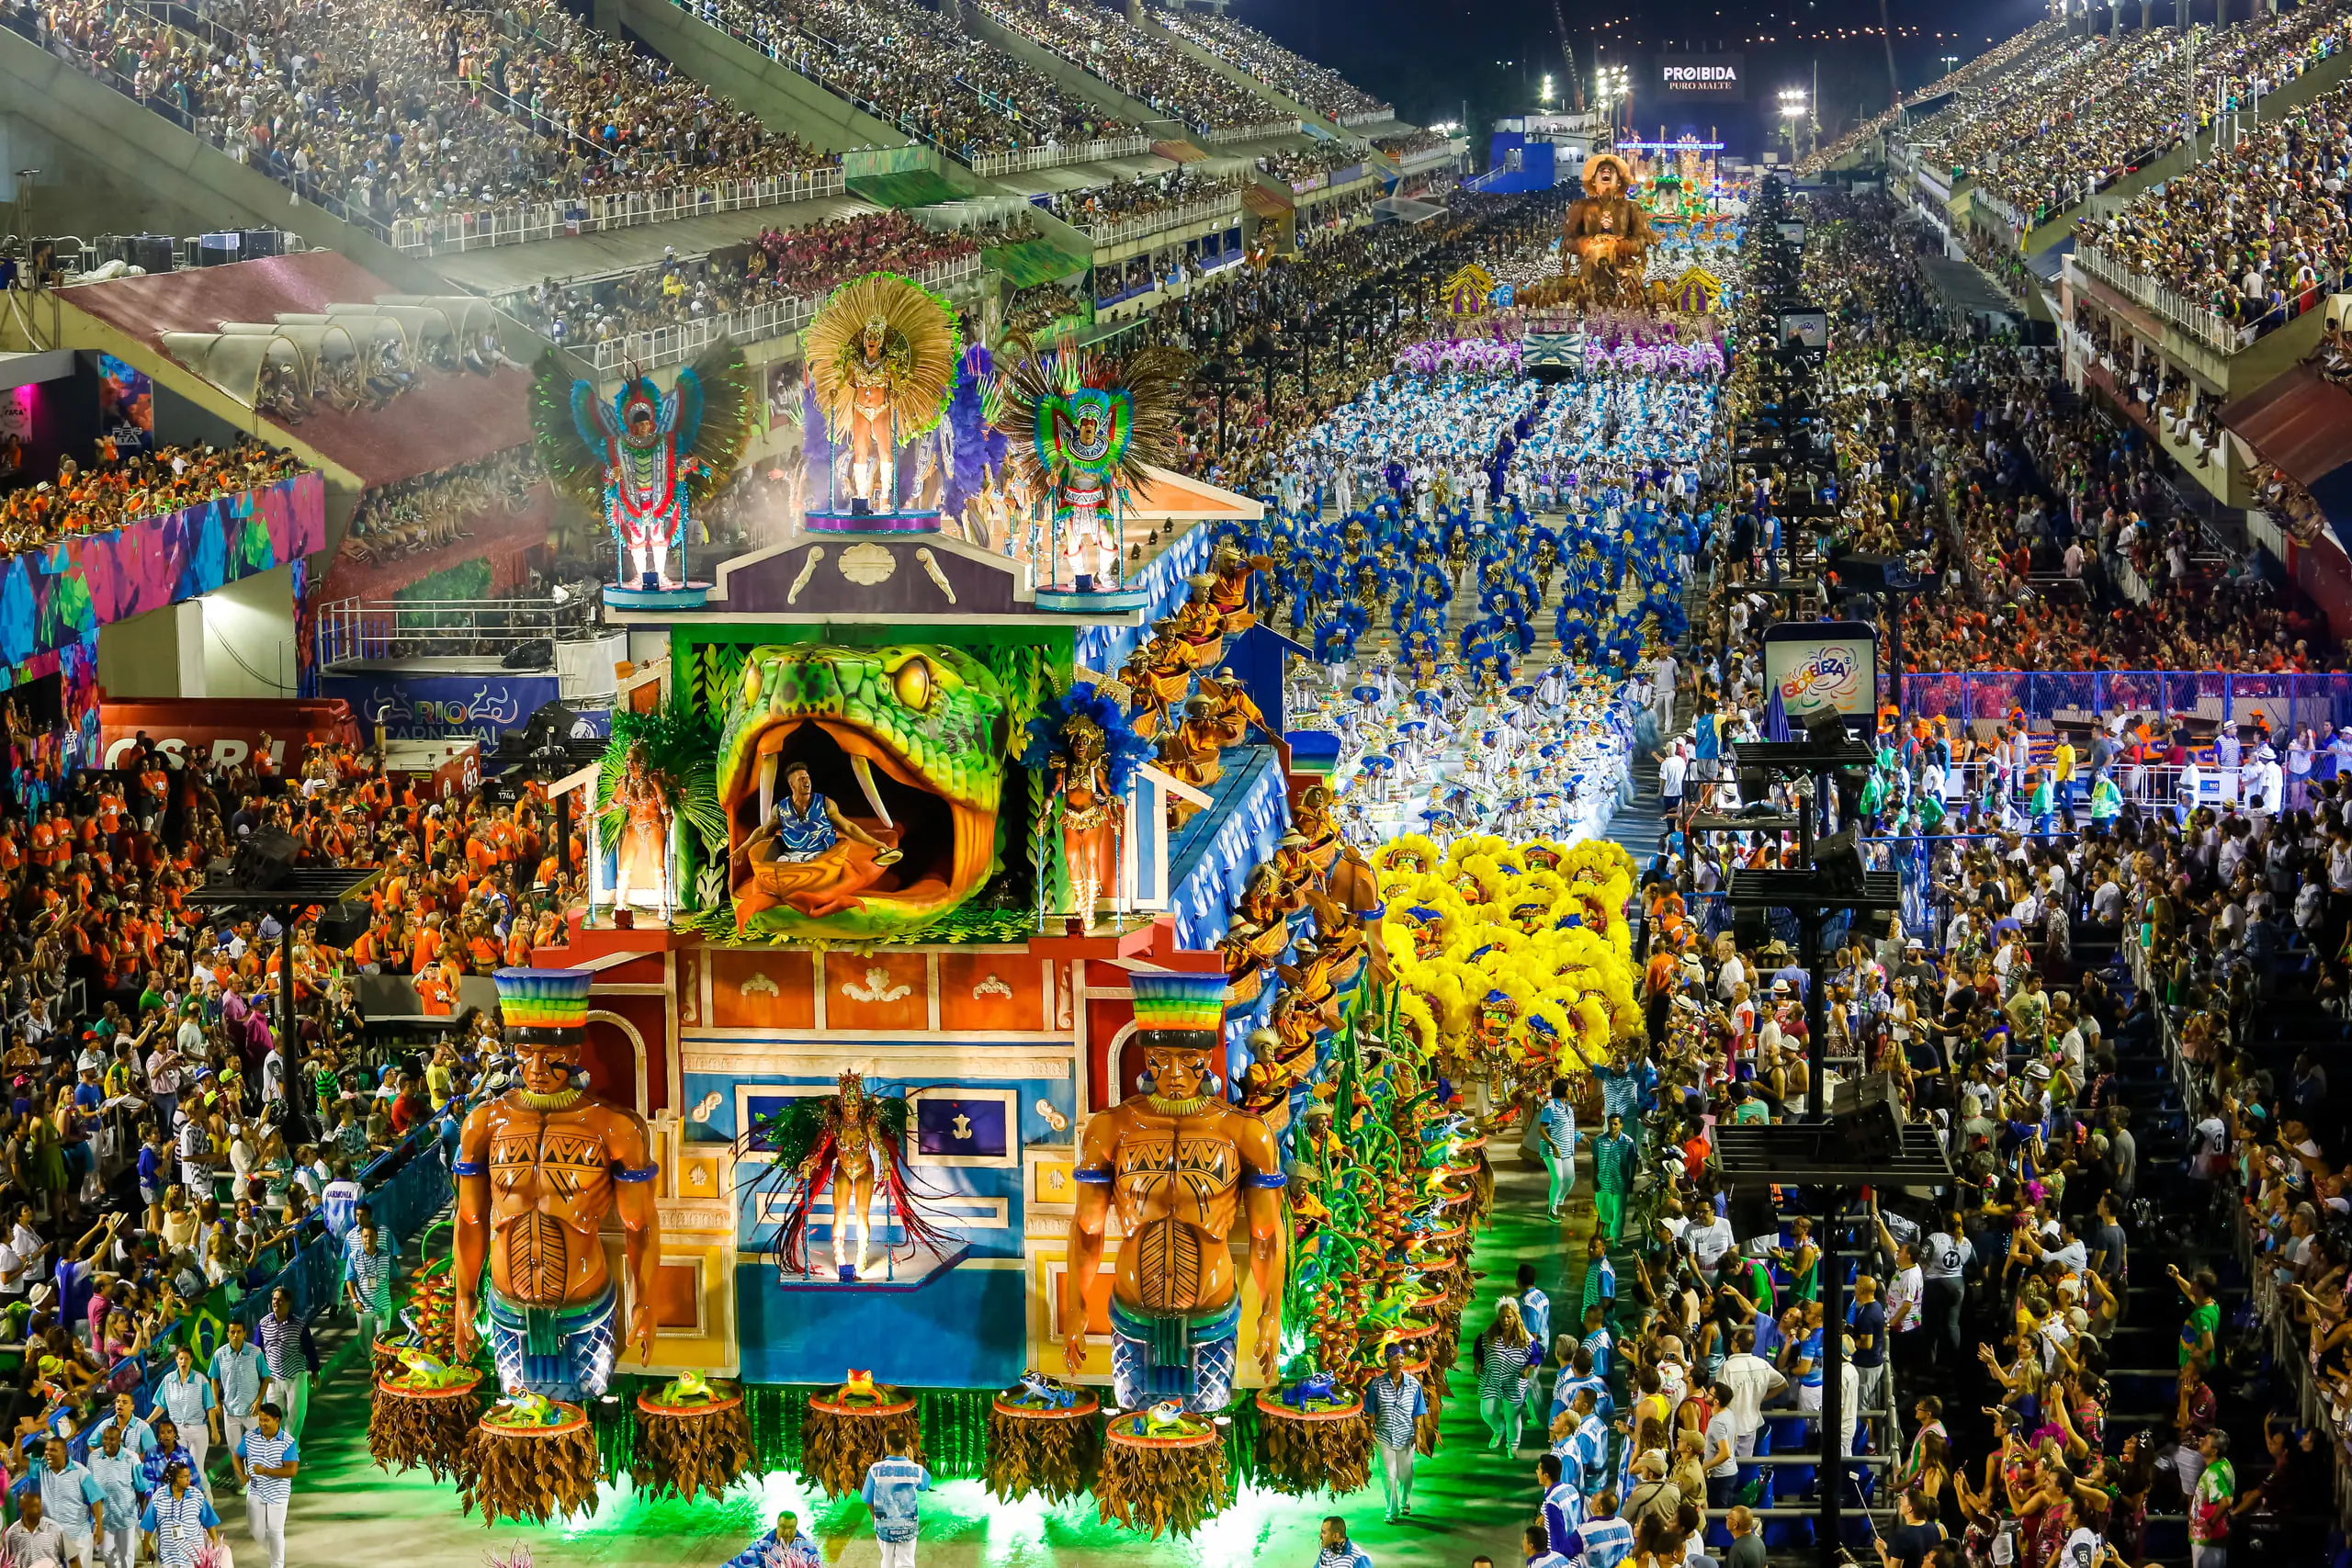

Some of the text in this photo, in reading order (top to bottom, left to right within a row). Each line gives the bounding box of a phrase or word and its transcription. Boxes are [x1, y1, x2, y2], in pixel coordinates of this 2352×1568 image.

[1669, 82, 1732, 90] PURO MALTE
[1781, 658, 1847, 698] GLOBELEZA
[414, 700, 468, 725] RIO
[462, 766, 478, 795] 193
[2209, 781, 2219, 789] RIO
[497, 791, 516, 800] 1746
